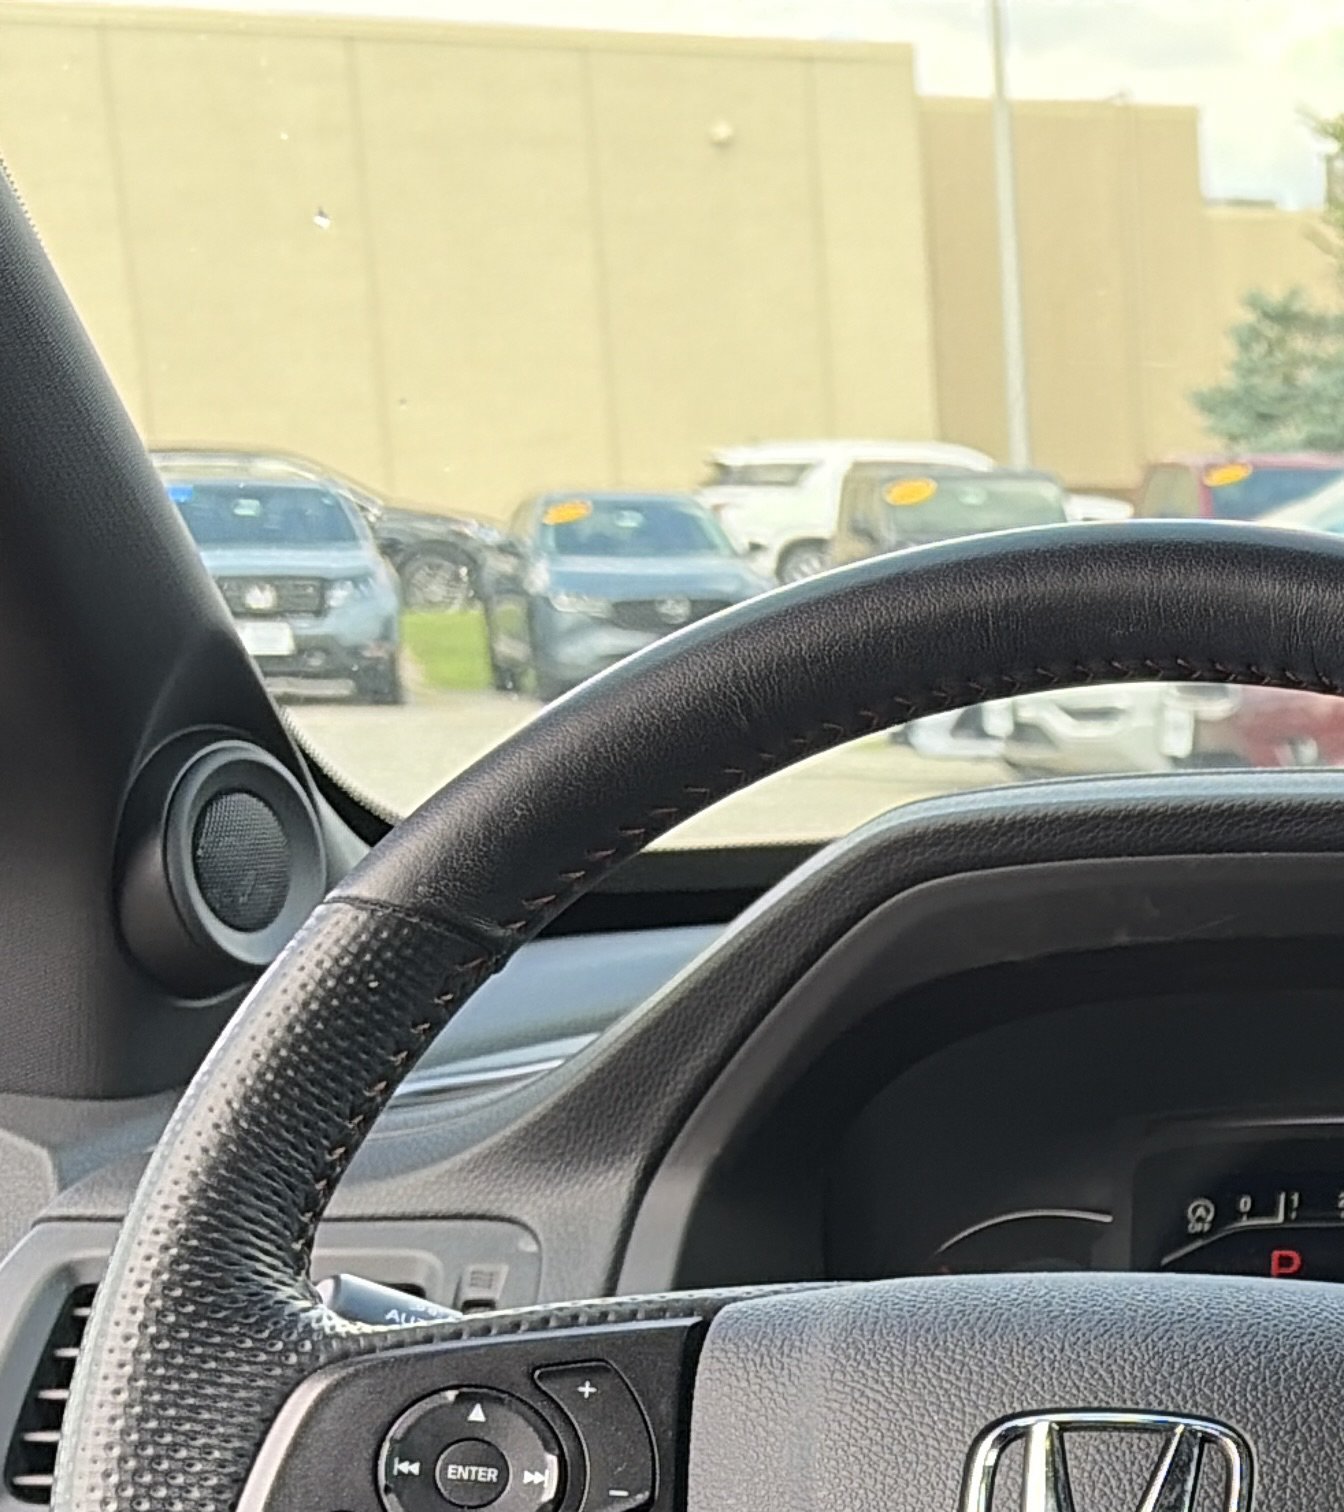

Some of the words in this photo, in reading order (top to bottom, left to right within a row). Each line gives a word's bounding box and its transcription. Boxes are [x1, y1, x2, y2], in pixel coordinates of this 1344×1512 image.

[1239, 1193, 1252, 1213] 0
[1291, 1191, 1300, 1208] 1
[1270, 1250, 1301, 1277] P
[447, 1465, 499, 1484] ENTER
